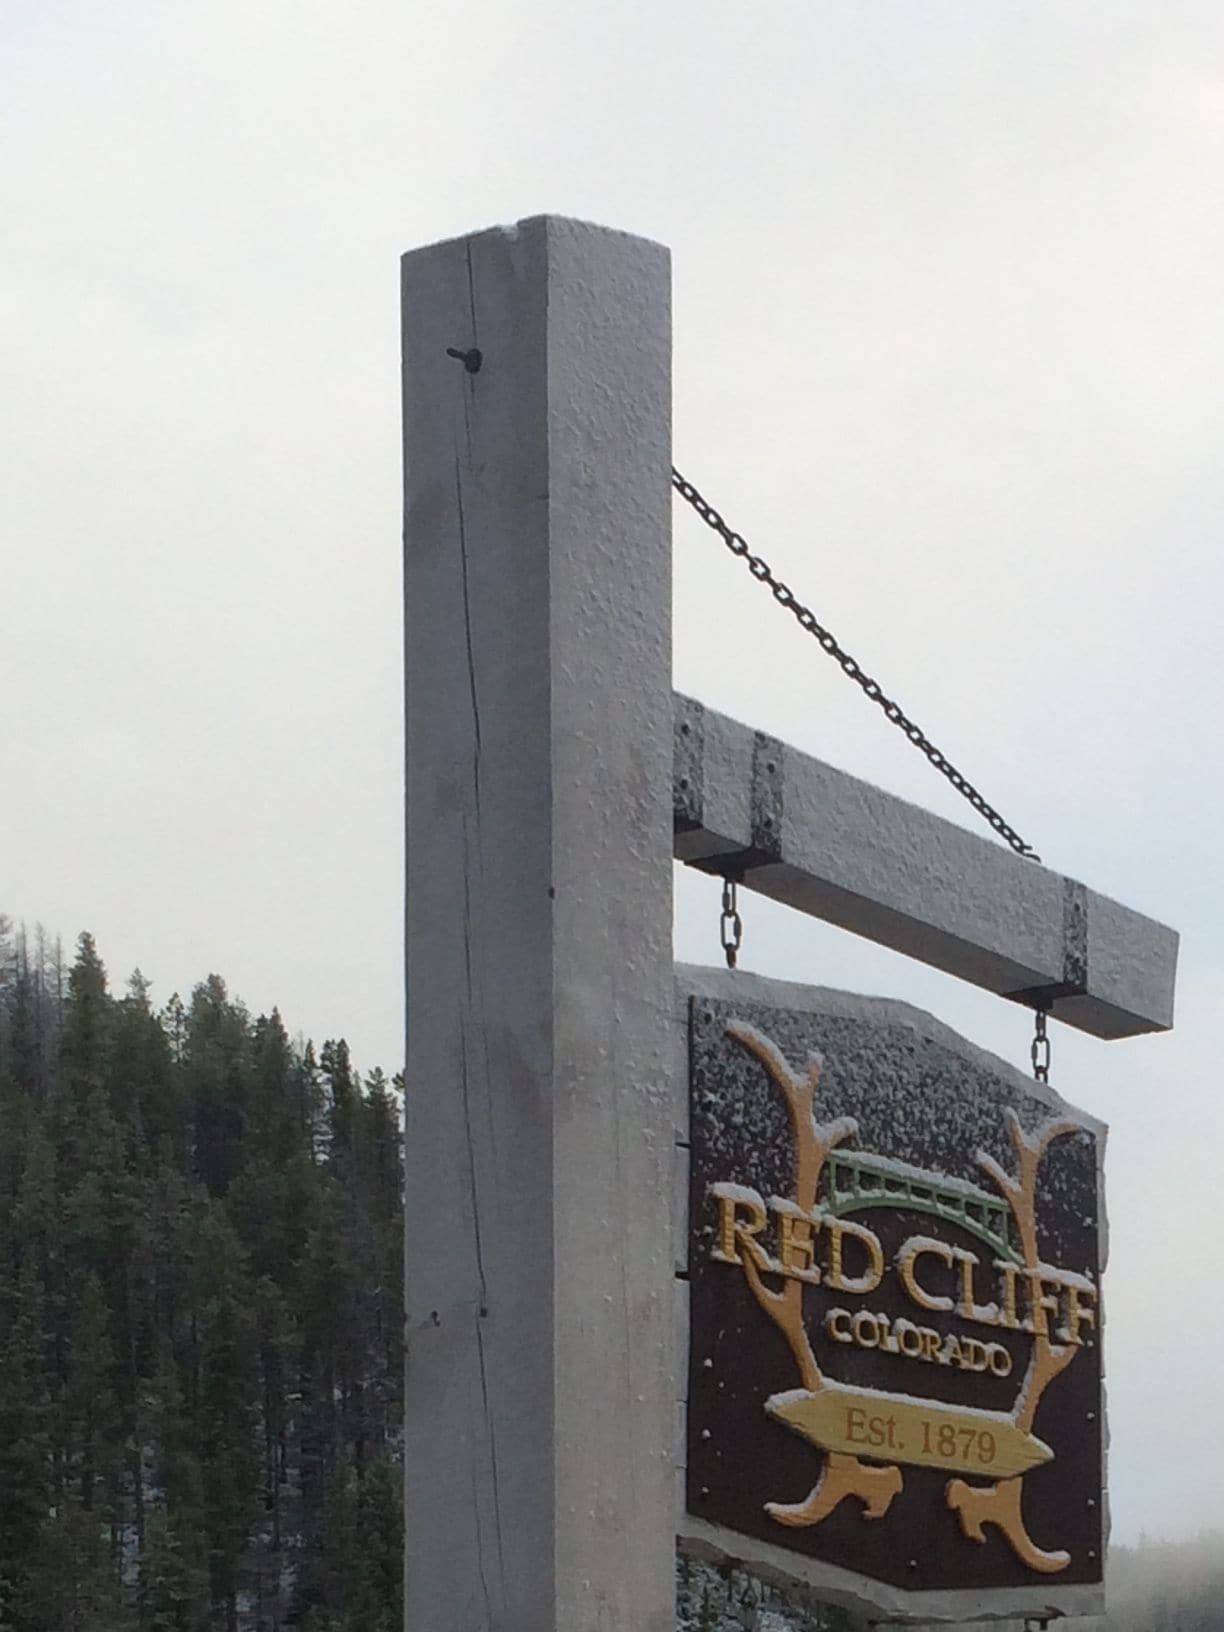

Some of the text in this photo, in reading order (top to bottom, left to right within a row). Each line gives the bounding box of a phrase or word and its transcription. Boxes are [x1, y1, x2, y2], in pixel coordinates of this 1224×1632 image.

[710, 1182, 1097, 1346] RED CLIFF
[825, 1307, 1013, 1377] COLORADO
[845, 1407, 996, 1464] Est. 1879
